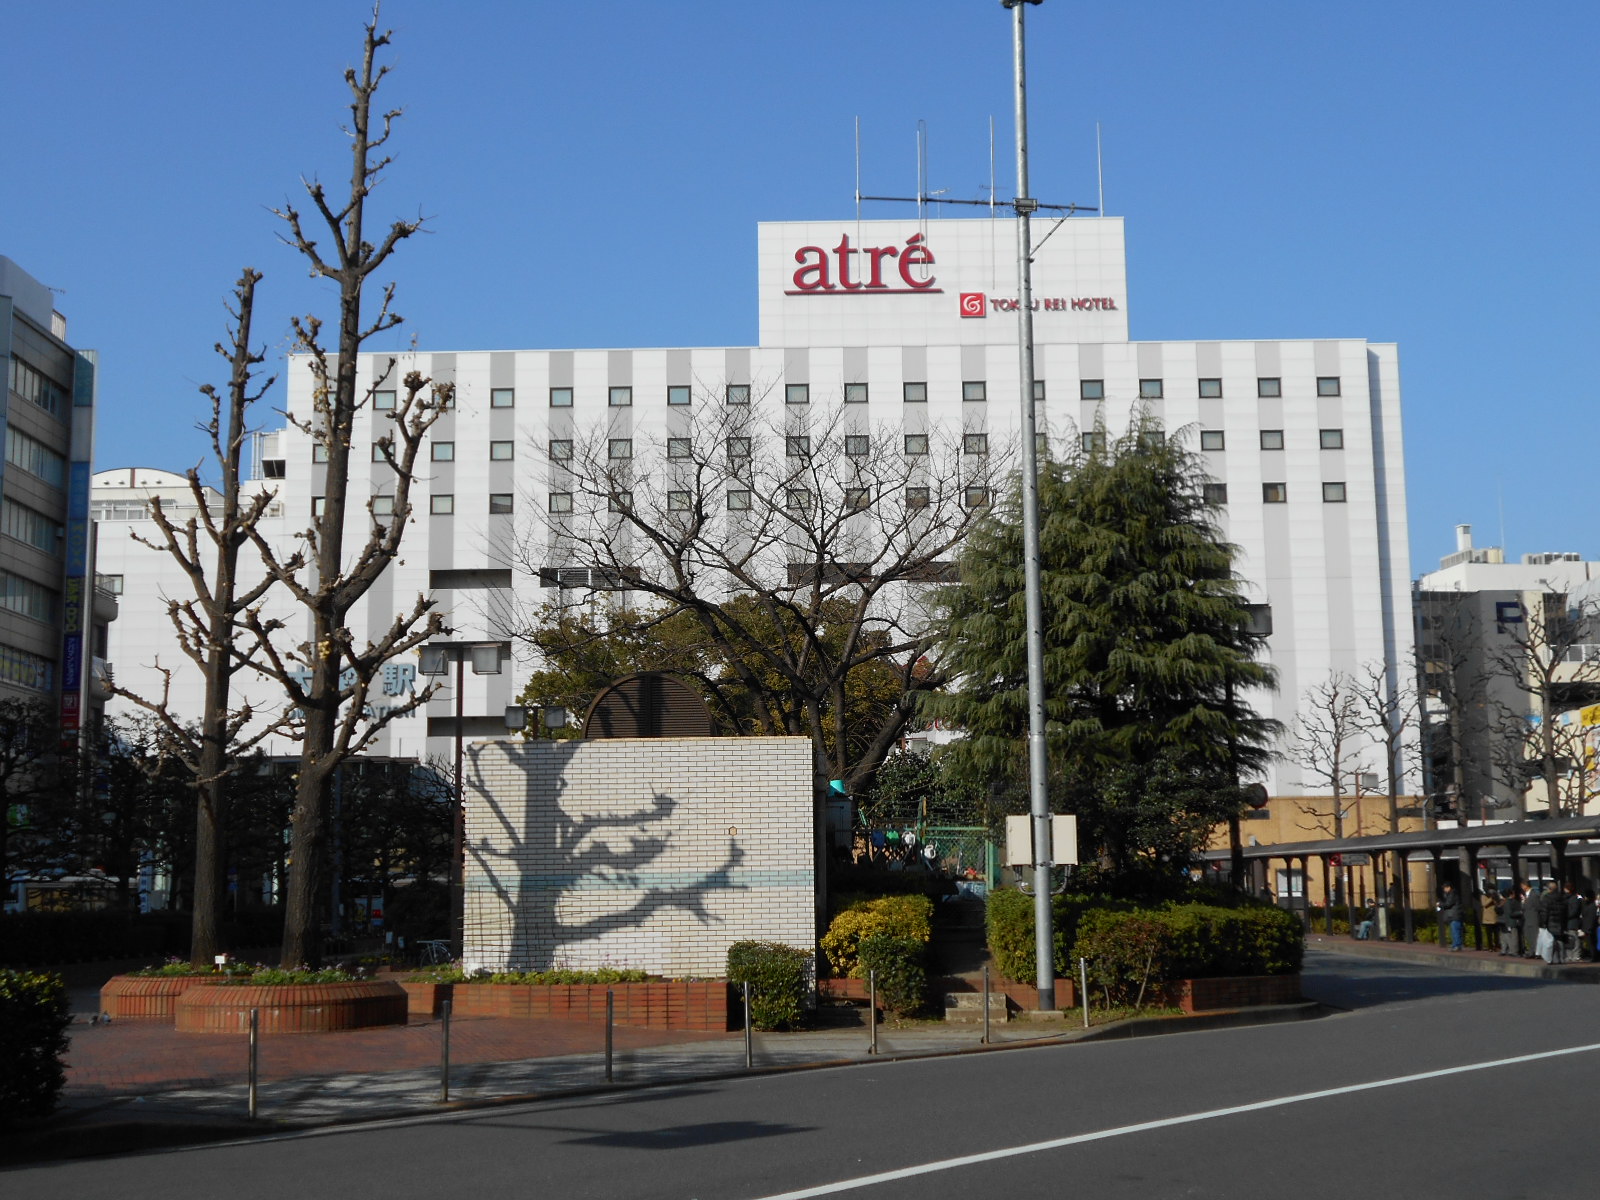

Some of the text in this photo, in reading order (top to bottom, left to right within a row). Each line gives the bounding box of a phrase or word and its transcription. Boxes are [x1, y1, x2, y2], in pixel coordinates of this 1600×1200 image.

[793, 233, 936, 289] atré
[990, 297, 1119, 311] TOKU REI HOTEL
